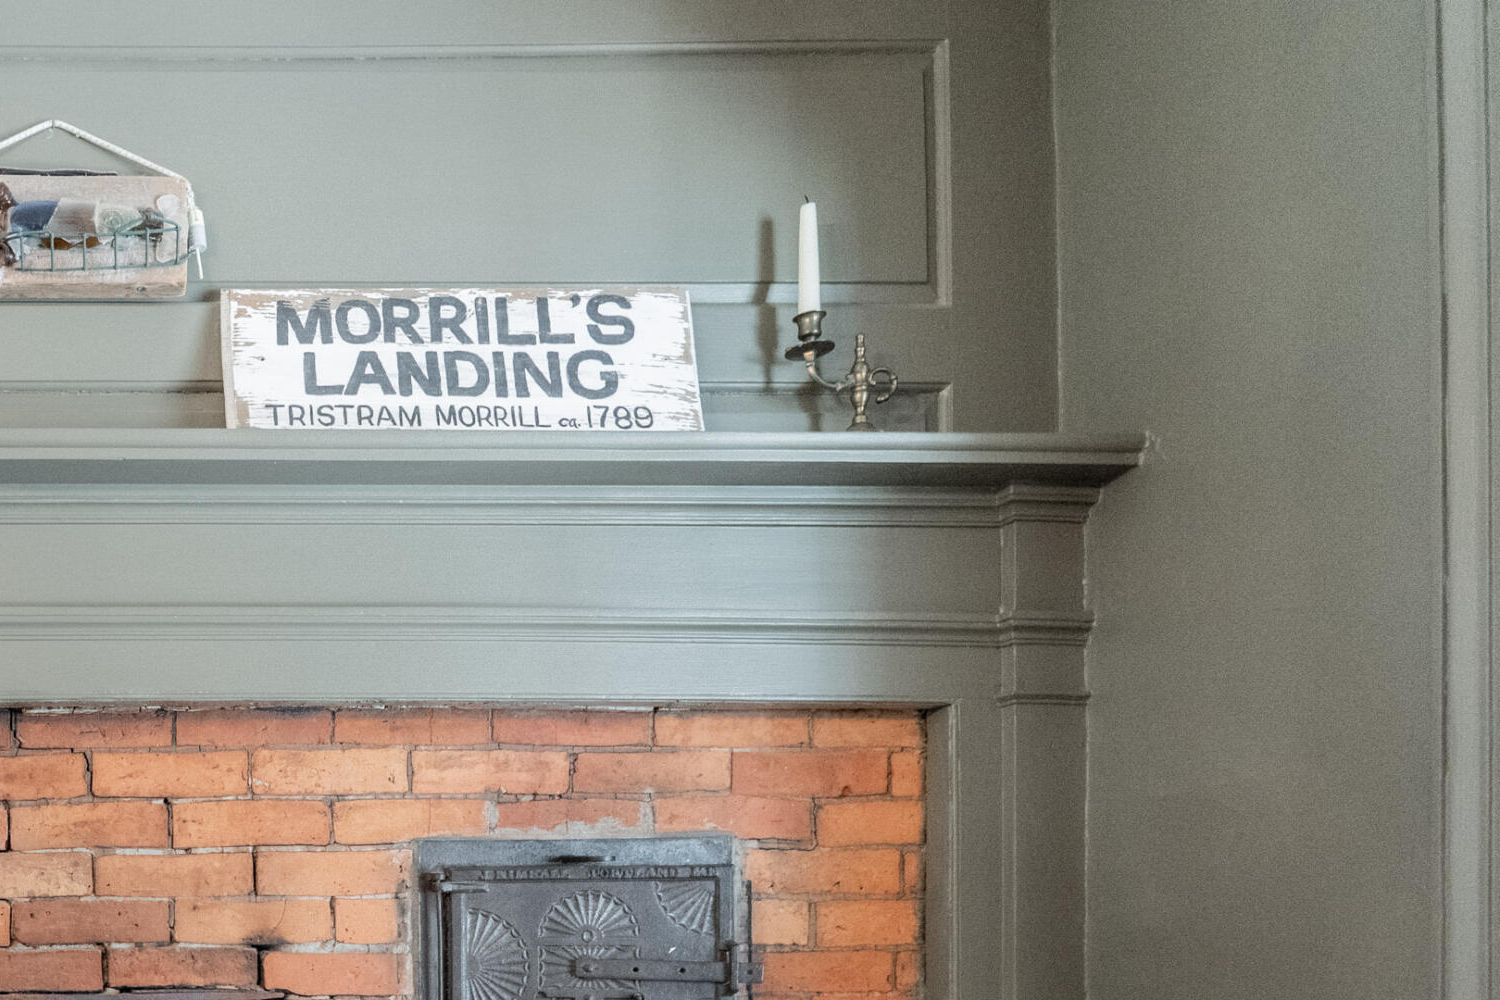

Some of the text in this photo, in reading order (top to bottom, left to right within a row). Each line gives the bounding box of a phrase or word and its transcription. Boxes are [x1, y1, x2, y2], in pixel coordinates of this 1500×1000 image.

[275, 293, 636, 346] MORRILL'S
[303, 349, 620, 400] LANDING
[264, 403, 422, 427] TRISTRAM
[435, 404, 552, 428] MORRILL
[586, 405, 654, 430] 1789
